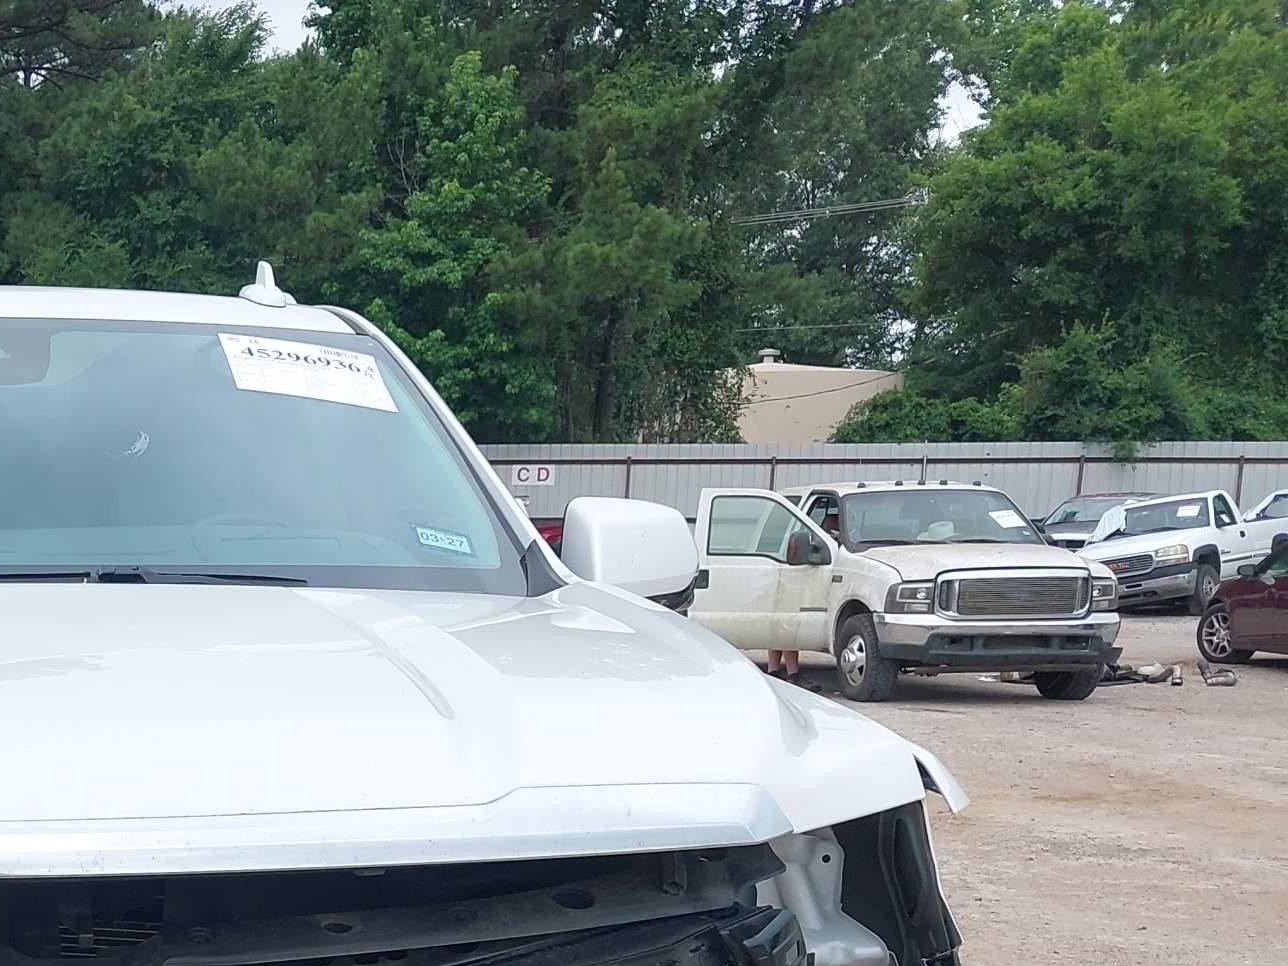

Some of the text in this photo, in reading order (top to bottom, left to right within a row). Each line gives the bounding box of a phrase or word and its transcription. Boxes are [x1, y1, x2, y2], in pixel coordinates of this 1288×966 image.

[240, 346, 361, 374] 45296936
[517, 467, 550, 482] C D
[420, 531, 465, 547] 03-27
